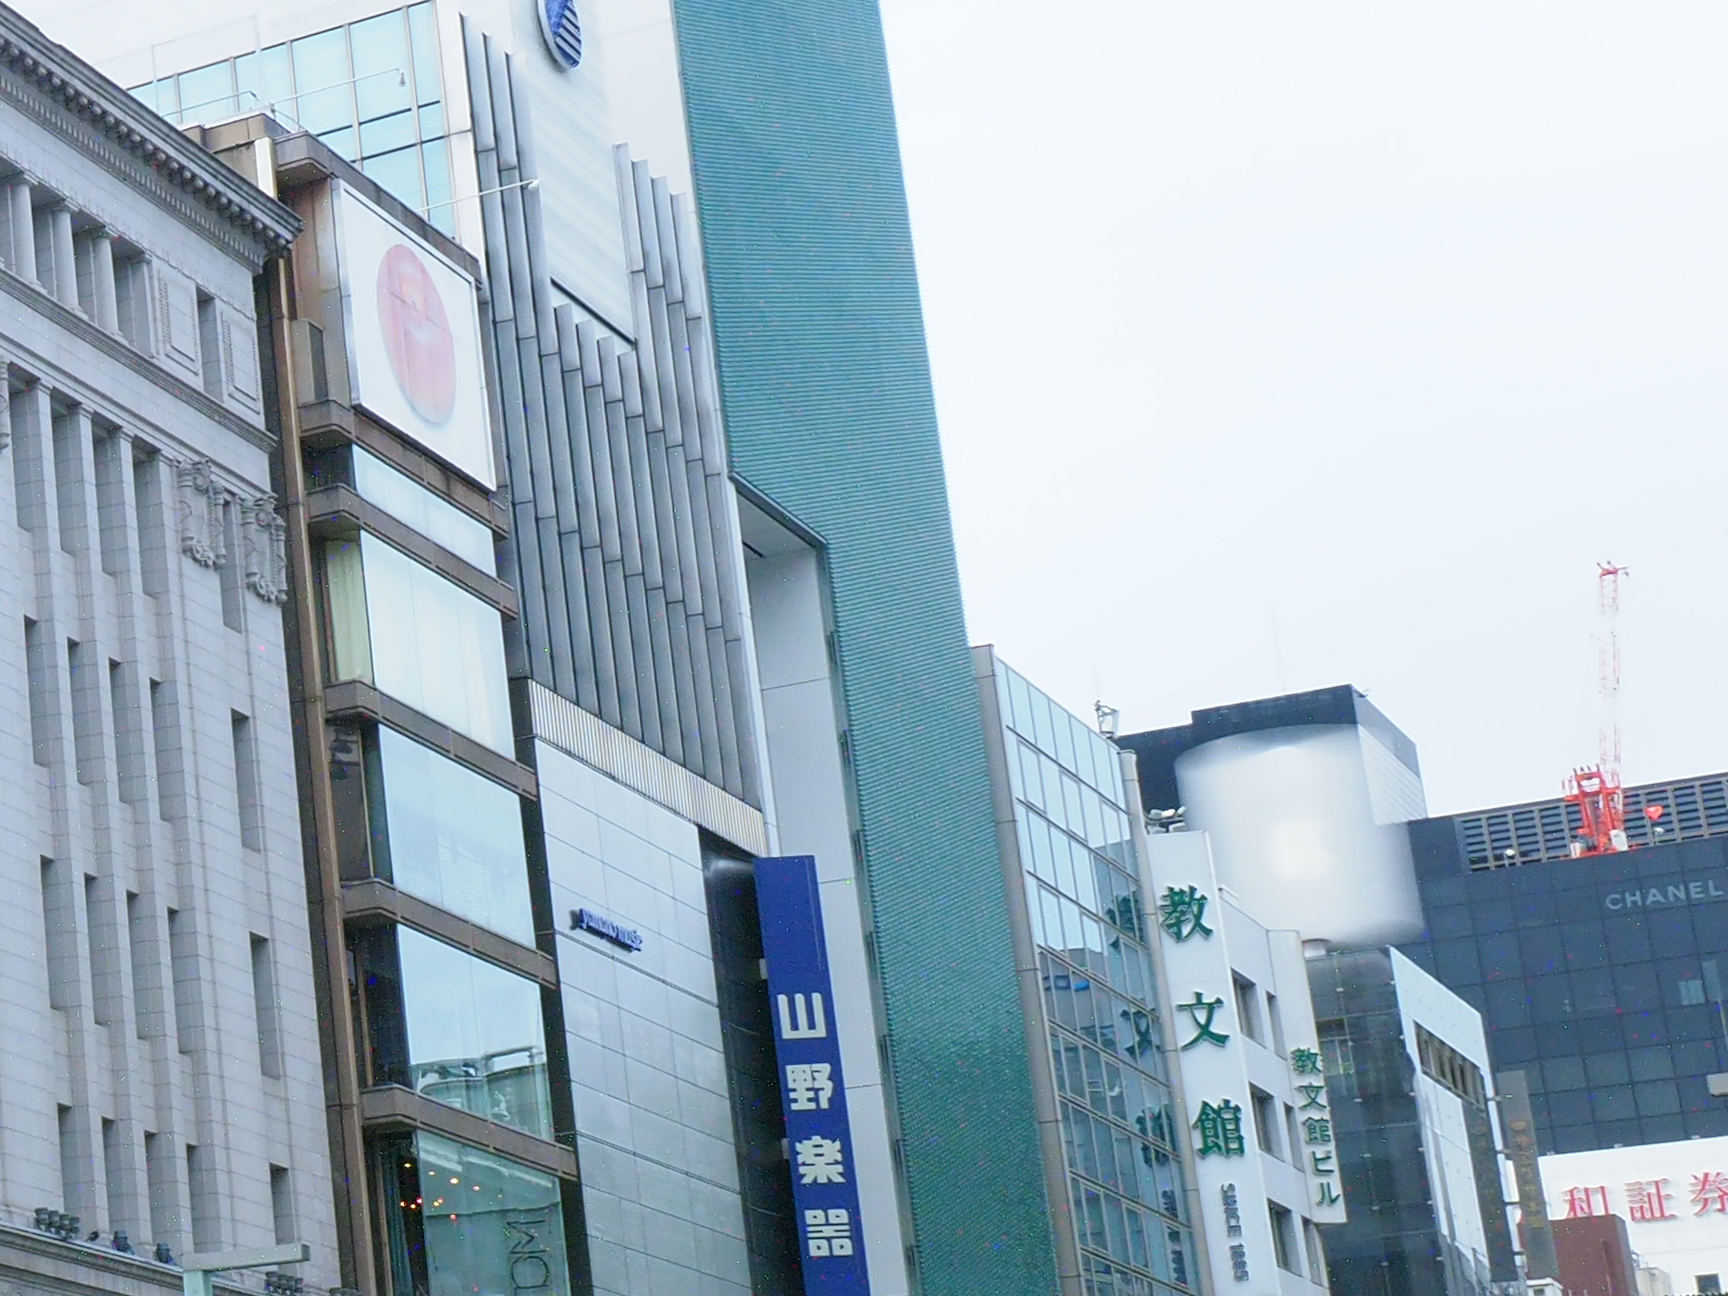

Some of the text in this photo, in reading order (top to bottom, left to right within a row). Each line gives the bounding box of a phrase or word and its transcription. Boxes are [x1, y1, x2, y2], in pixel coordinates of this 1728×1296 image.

[1605, 879, 1726, 911] CHANEL
[776, 991, 854, 1258] 山野楽器
[1158, 882, 1246, 1159] 教文館
[1290, 1046, 1342, 1208] 教文館ビル
